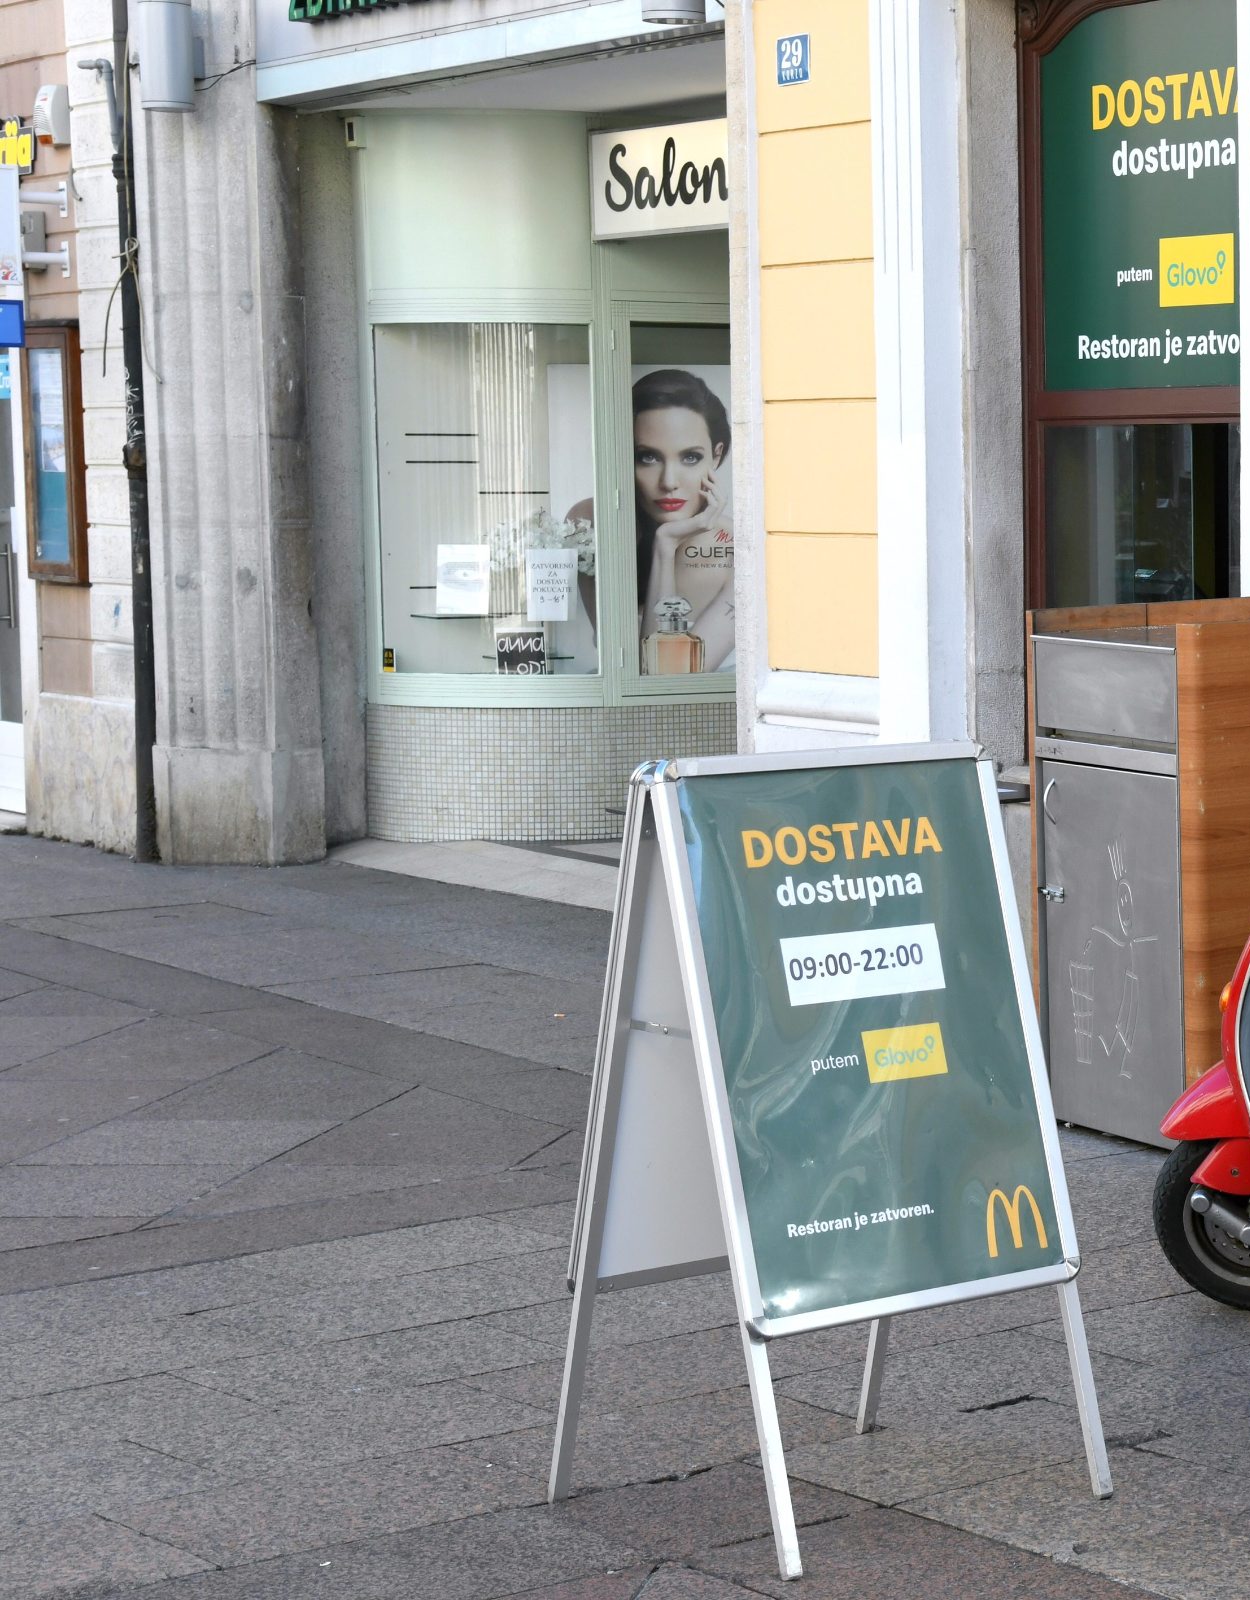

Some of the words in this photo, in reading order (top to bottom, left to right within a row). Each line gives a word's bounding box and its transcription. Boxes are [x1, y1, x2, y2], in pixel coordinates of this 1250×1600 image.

[781, 38, 803, 69] 29
[1092, 66, 1239, 131] DOSTAV
[605, 136, 729, 213] Salon
[1112, 137, 1237, 180] dostupna
[1117, 266, 1153, 287] putem
[1167, 262, 1218, 288] Glovo
[1078, 334, 1161, 360] Restoran
[1163, 328, 1183, 364] je
[1186, 329, 1240, 356] zatvo
[741, 816, 943, 869] DOSTAVA
[776, 872, 924, 906] dostupna
[788, 942, 924, 981] 09:00-22:00
[810, 1052, 860, 1075] putem
[874, 1047, 929, 1068] Glovo
[786, 1216, 852, 1238] Restoran
[853, 1211, 869, 1230] je
[870, 1201, 935, 1225] zatvoren.
